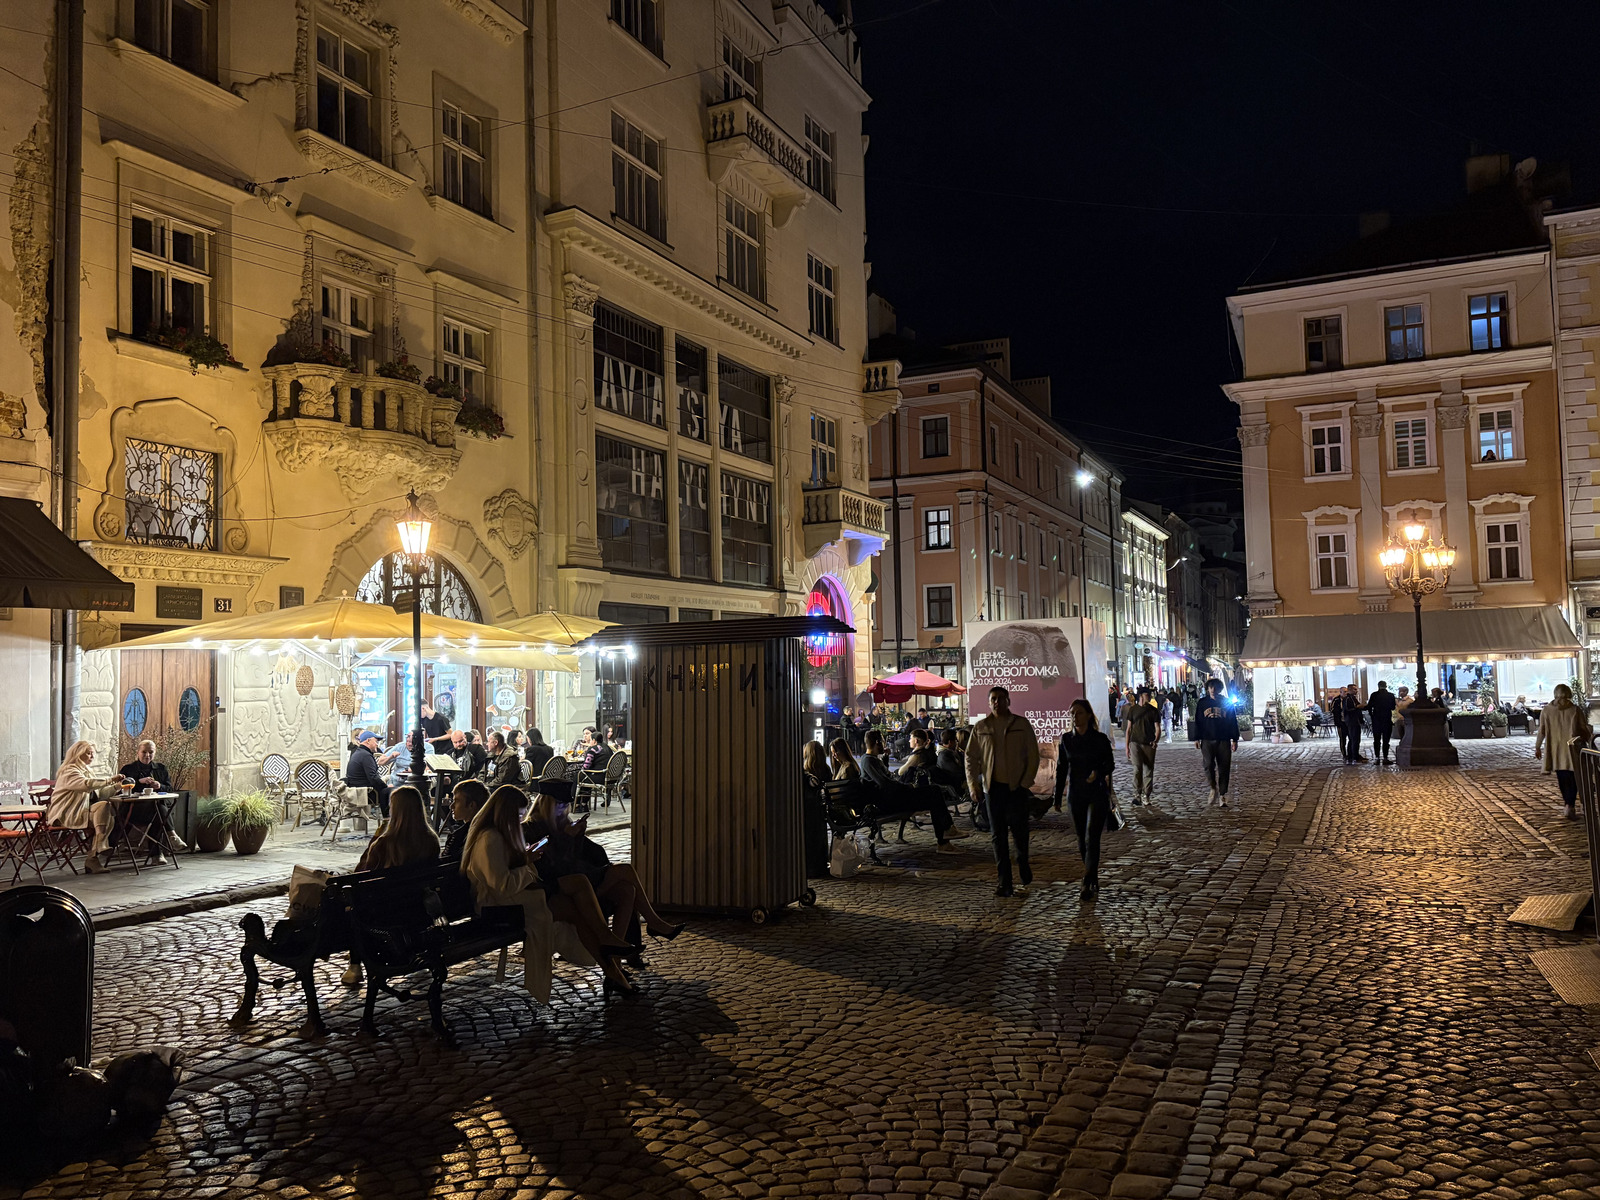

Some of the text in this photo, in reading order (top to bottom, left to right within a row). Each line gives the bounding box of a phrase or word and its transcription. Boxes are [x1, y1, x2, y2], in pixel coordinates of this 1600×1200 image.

[979, 651, 1006, 660] ДЕНИС
[973, 656, 1028, 667] ШИМАНСЬКИЙ
[973, 665, 1060, 678] ГОЛОВОЛОМКА
